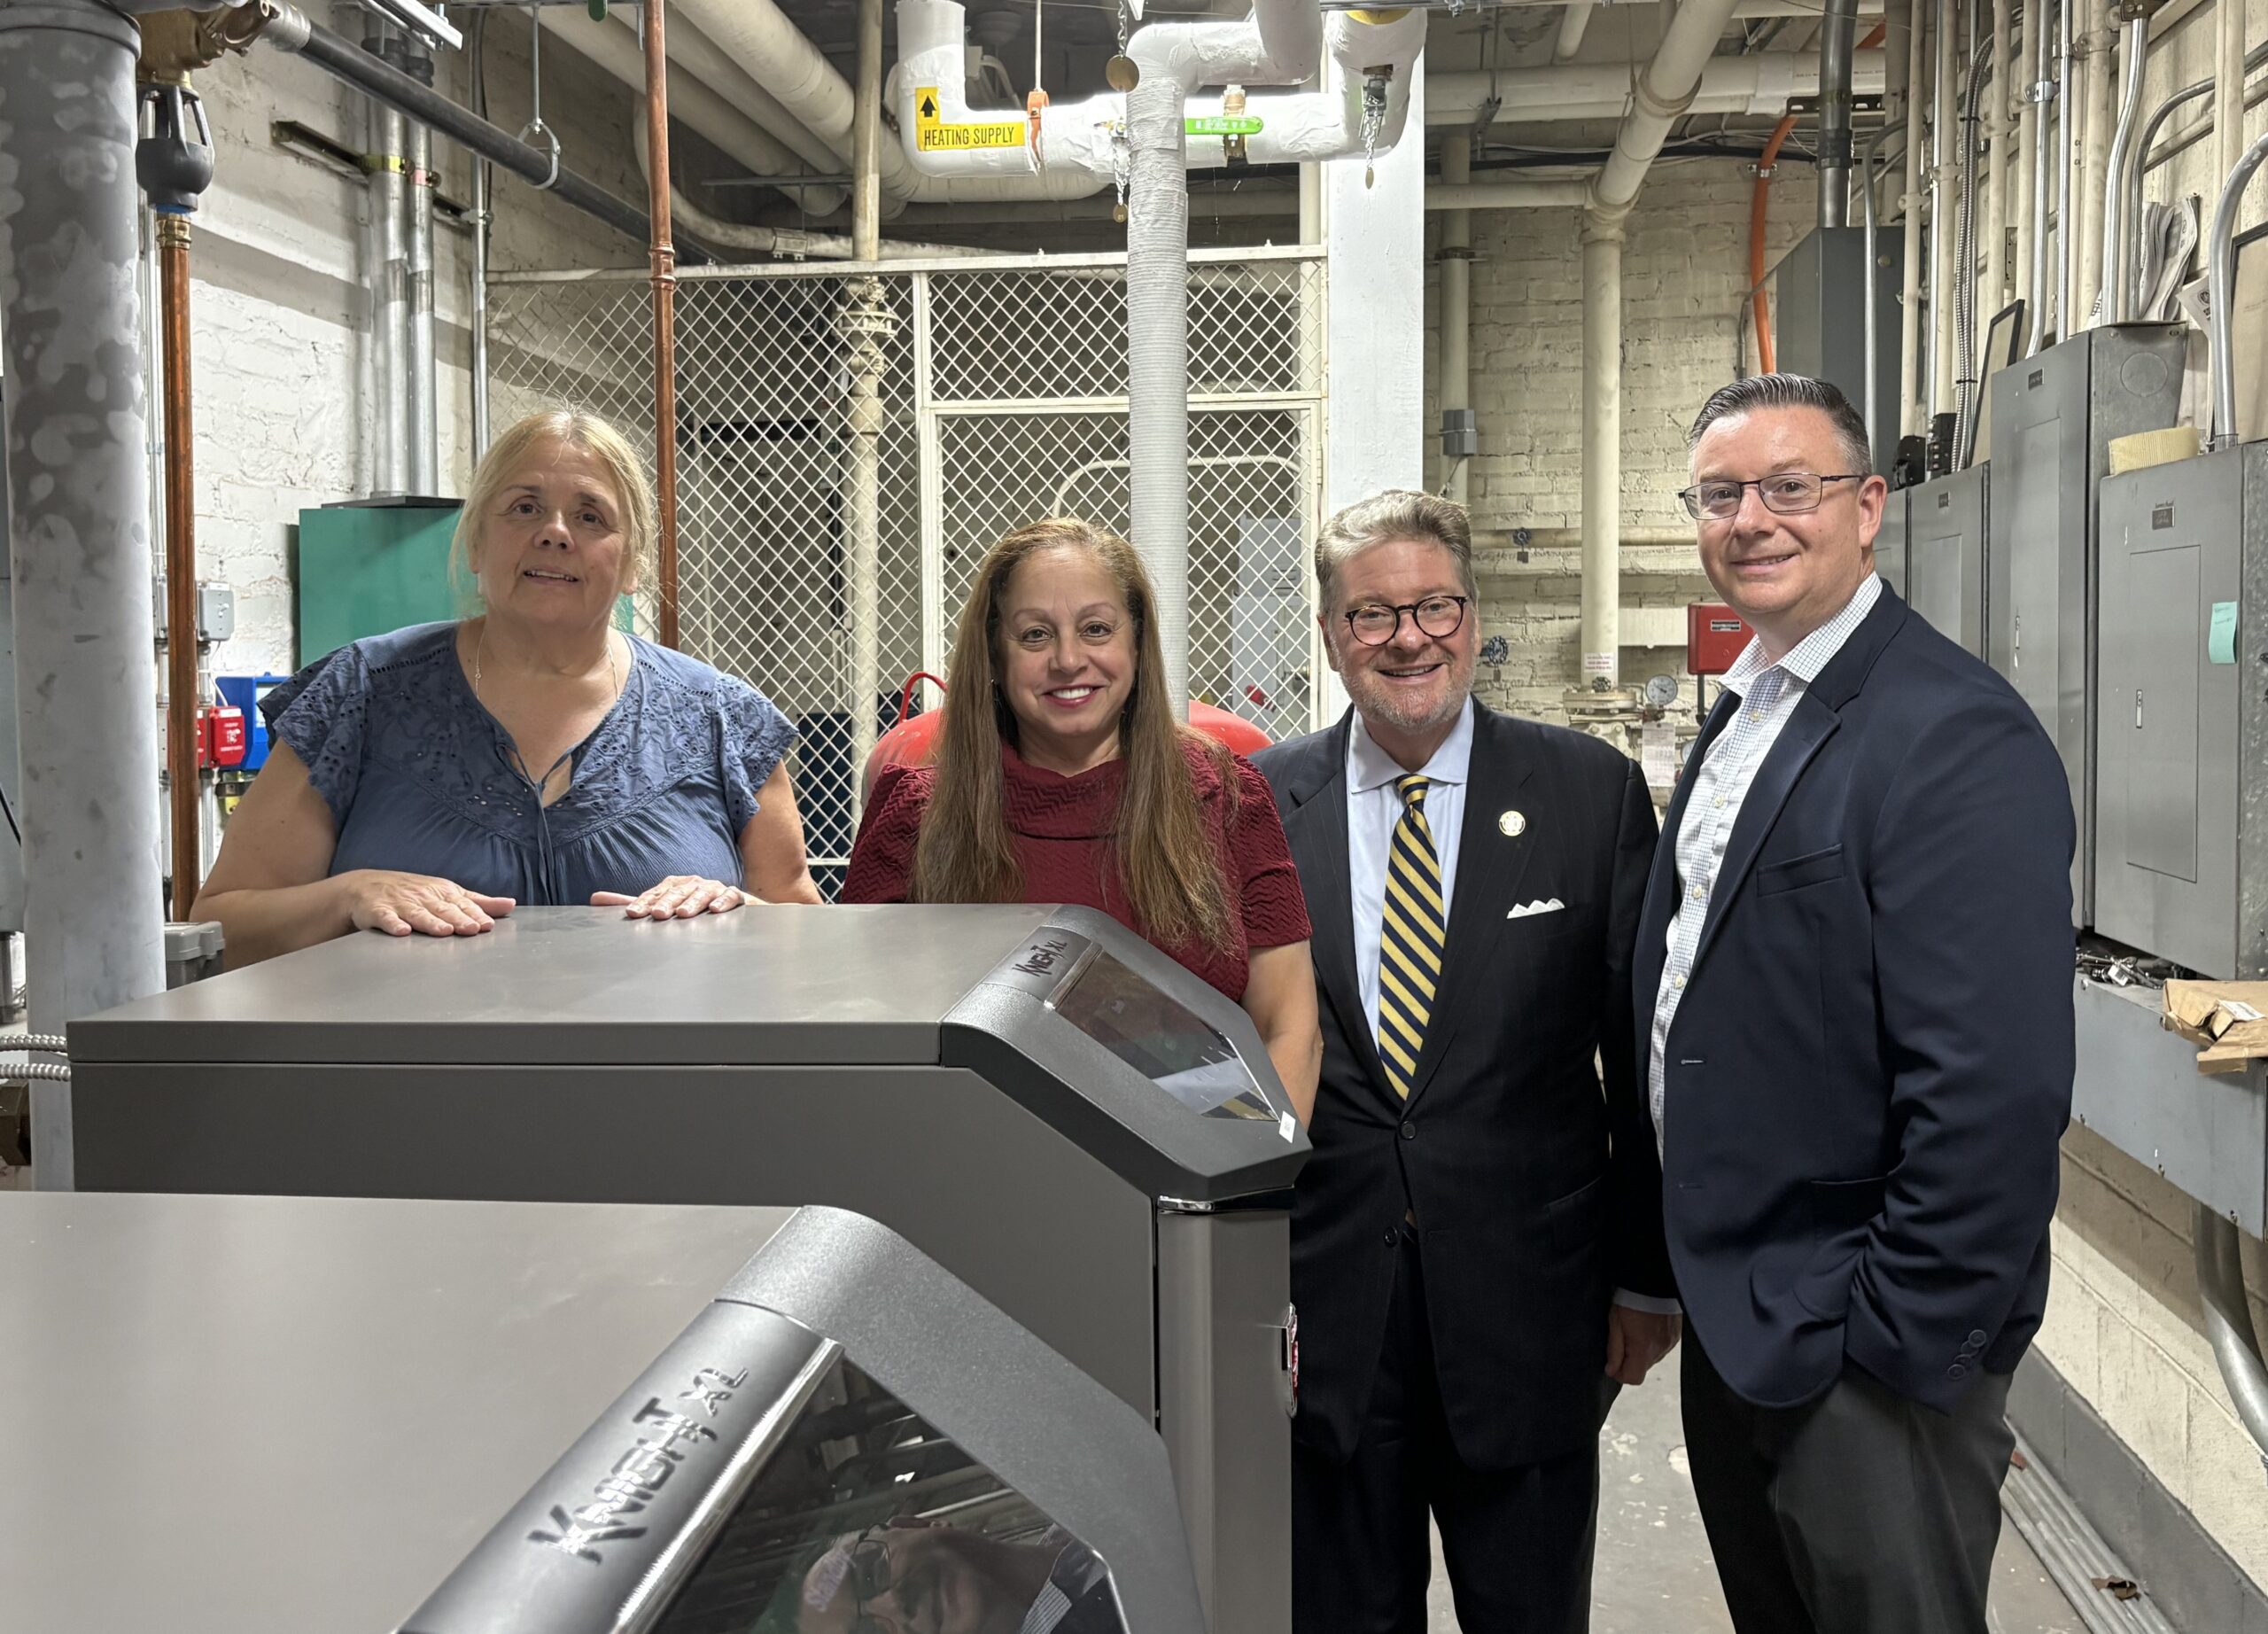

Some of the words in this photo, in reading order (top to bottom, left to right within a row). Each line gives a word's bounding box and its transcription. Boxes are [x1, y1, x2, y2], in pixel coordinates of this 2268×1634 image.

[924, 128, 969, 146] HEATING
[973, 127, 1014, 144] SUPPLY
[1012, 945, 1064, 977] KNIGHT
[1044, 939, 1068, 953] XL
[527, 1397, 718, 1565] KNIGHT
[676, 1367, 749, 1418] XL
